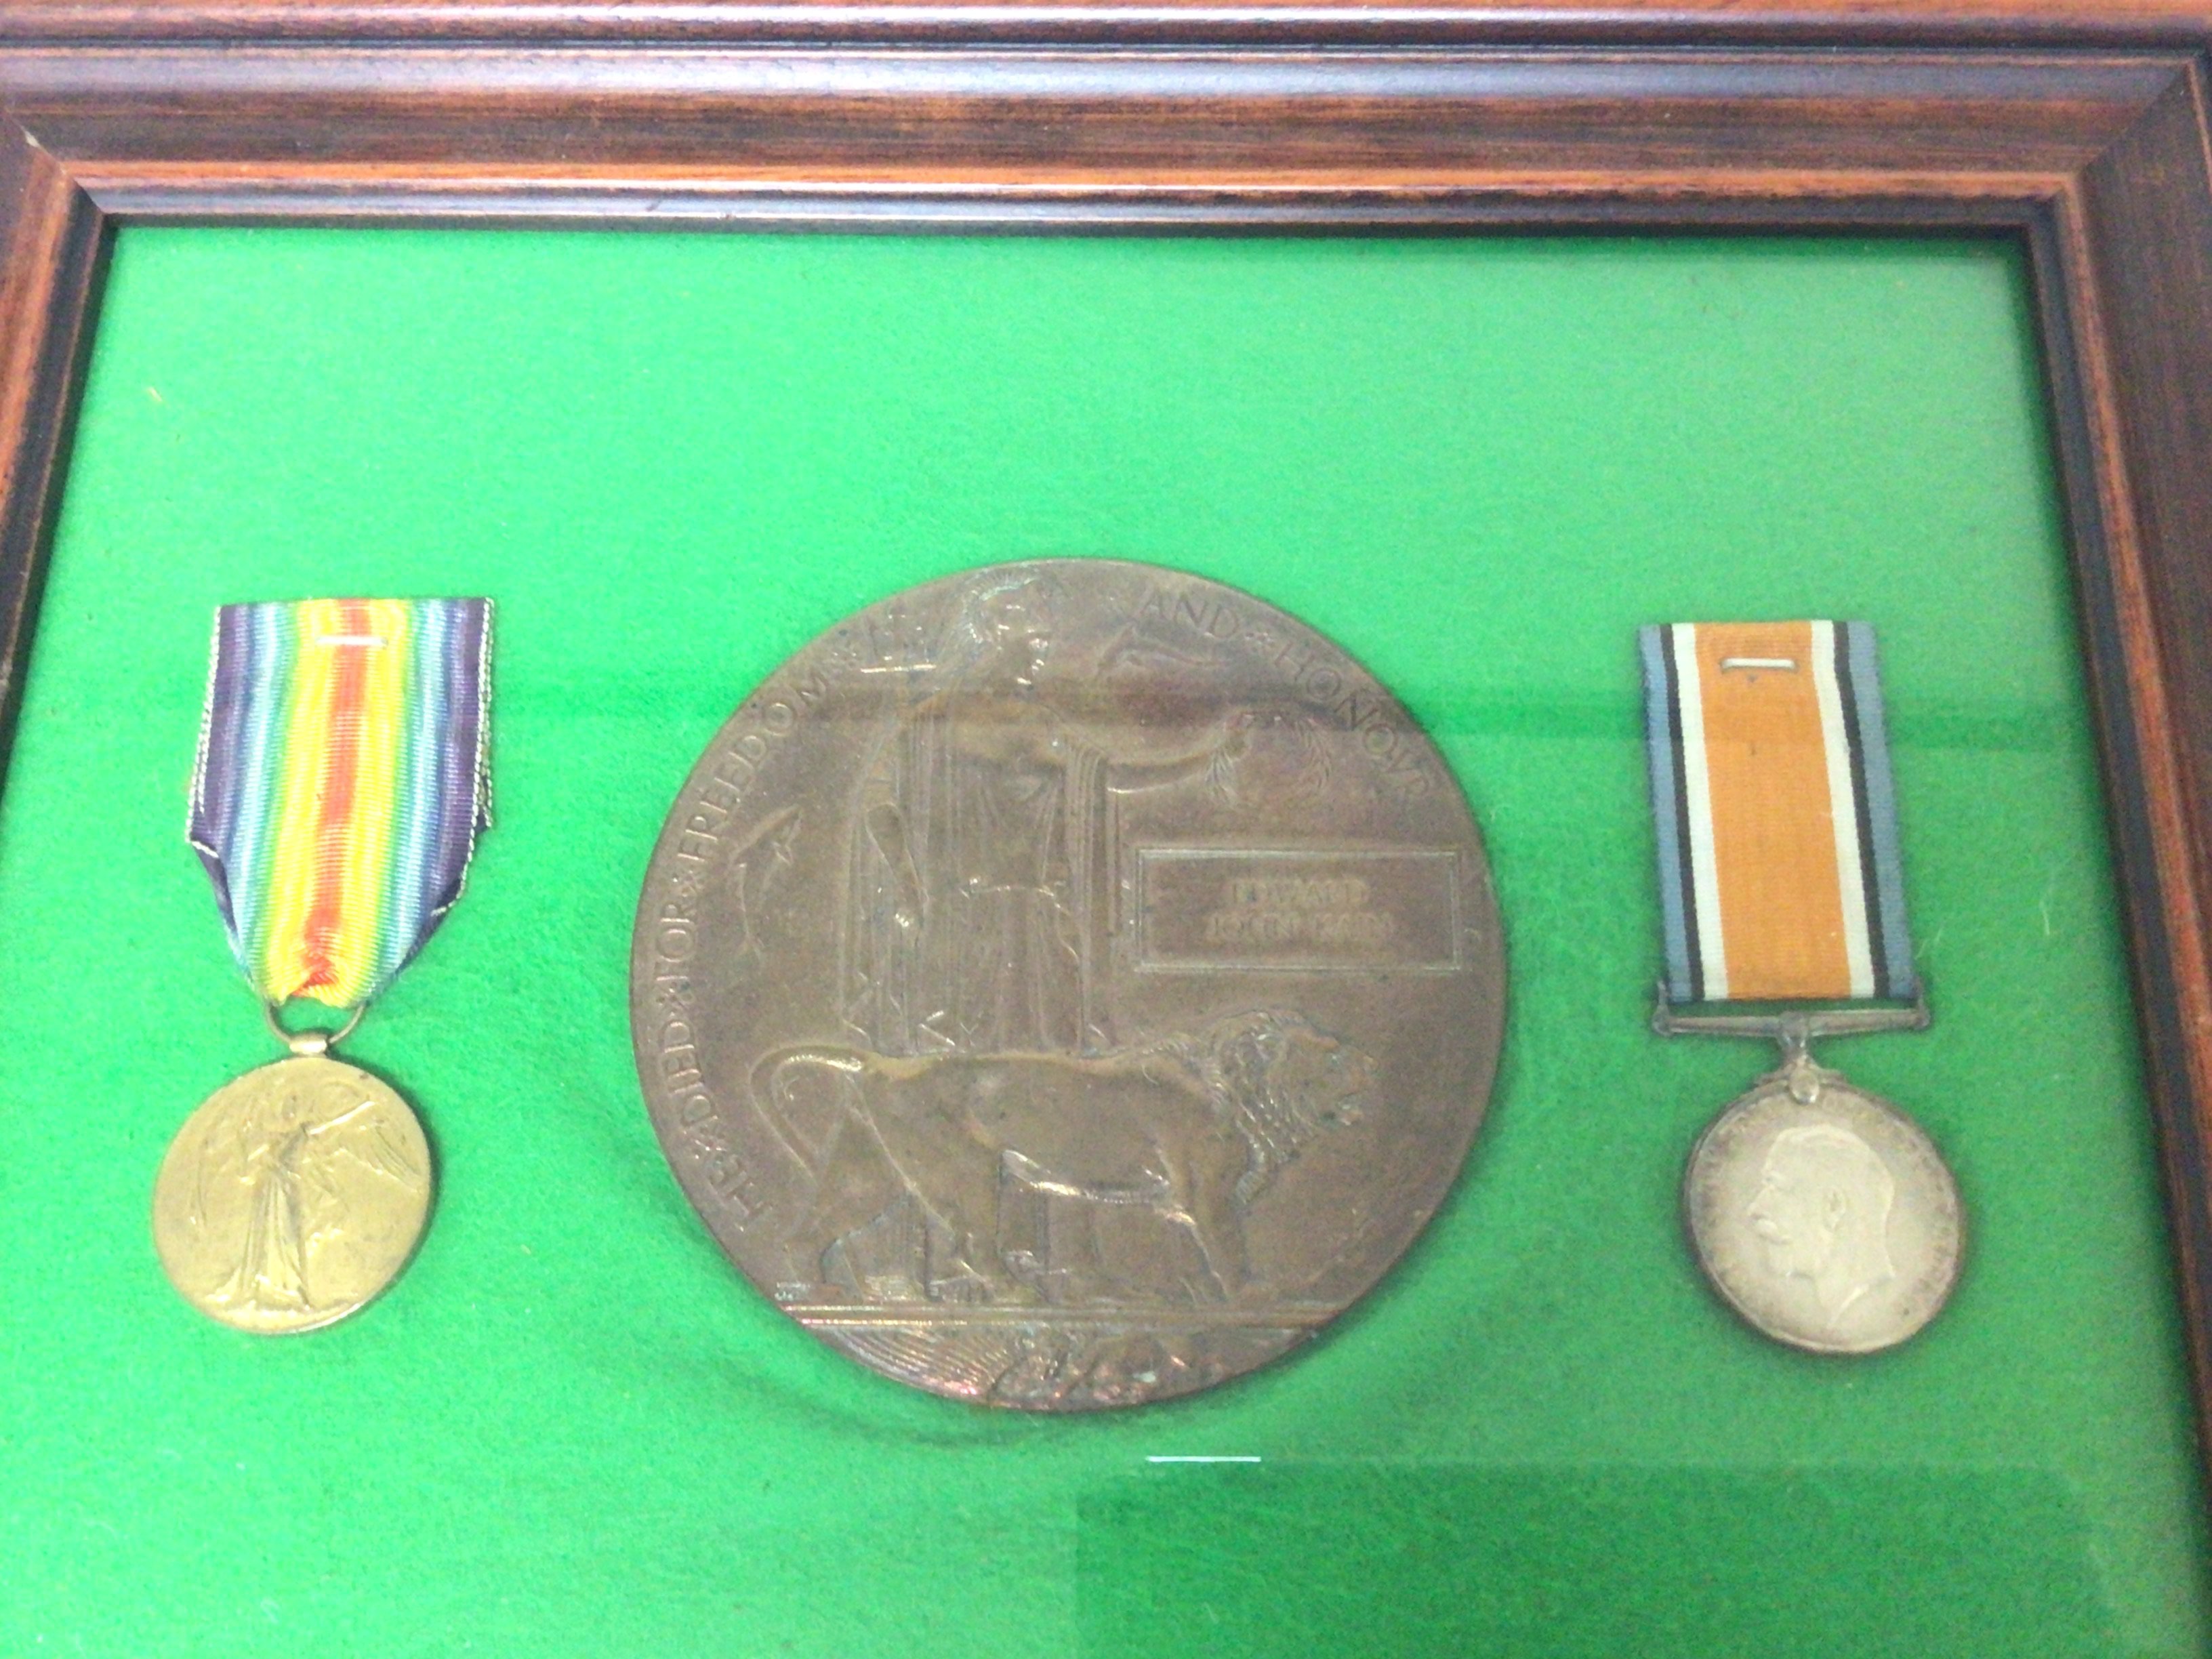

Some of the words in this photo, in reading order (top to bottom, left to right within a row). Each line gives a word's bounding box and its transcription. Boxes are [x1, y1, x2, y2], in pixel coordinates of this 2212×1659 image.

[1139, 588, 1240, 639] AND
[676, 662, 829, 862] FREEDOM
[655, 900, 698, 981] FOR
[659, 1019, 720, 1126] DIED
